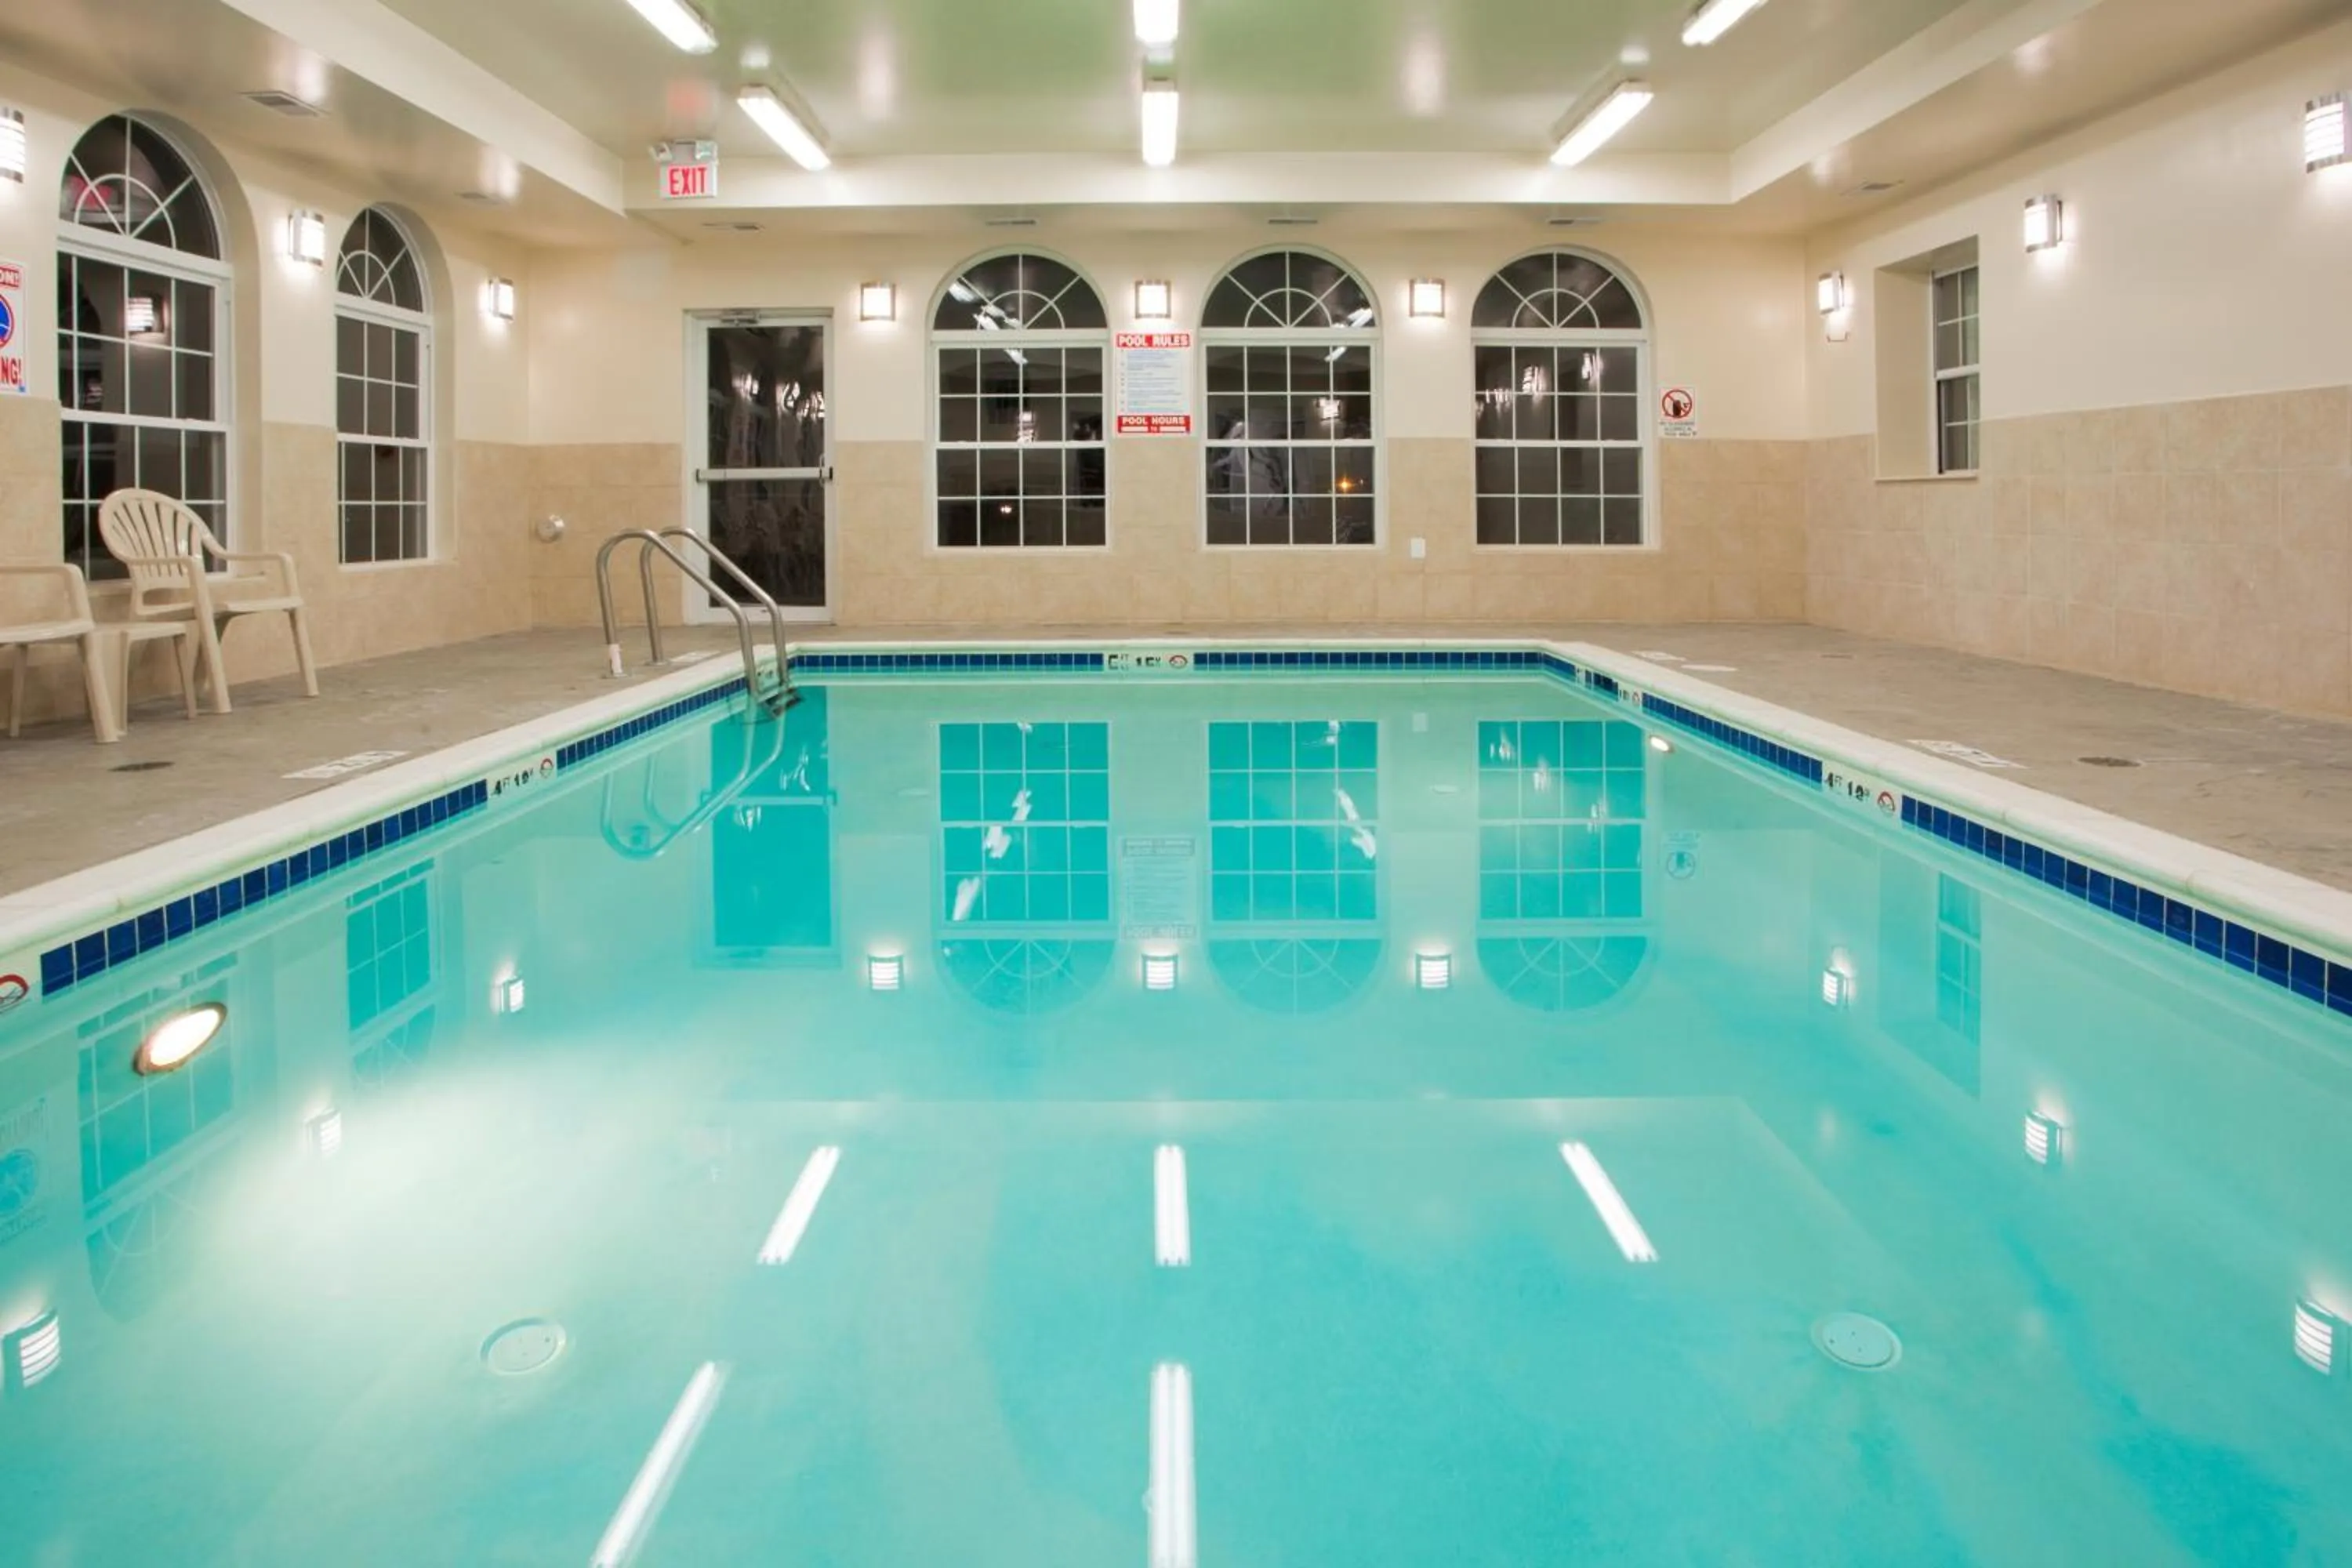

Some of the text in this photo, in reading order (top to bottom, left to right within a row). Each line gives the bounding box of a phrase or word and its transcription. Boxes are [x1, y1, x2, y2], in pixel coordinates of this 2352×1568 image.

[669, 166, 707, 195] EXIT
[1118, 335, 1188, 347] POOL RULES
[1122, 416, 1185, 425] POOL HOURS
